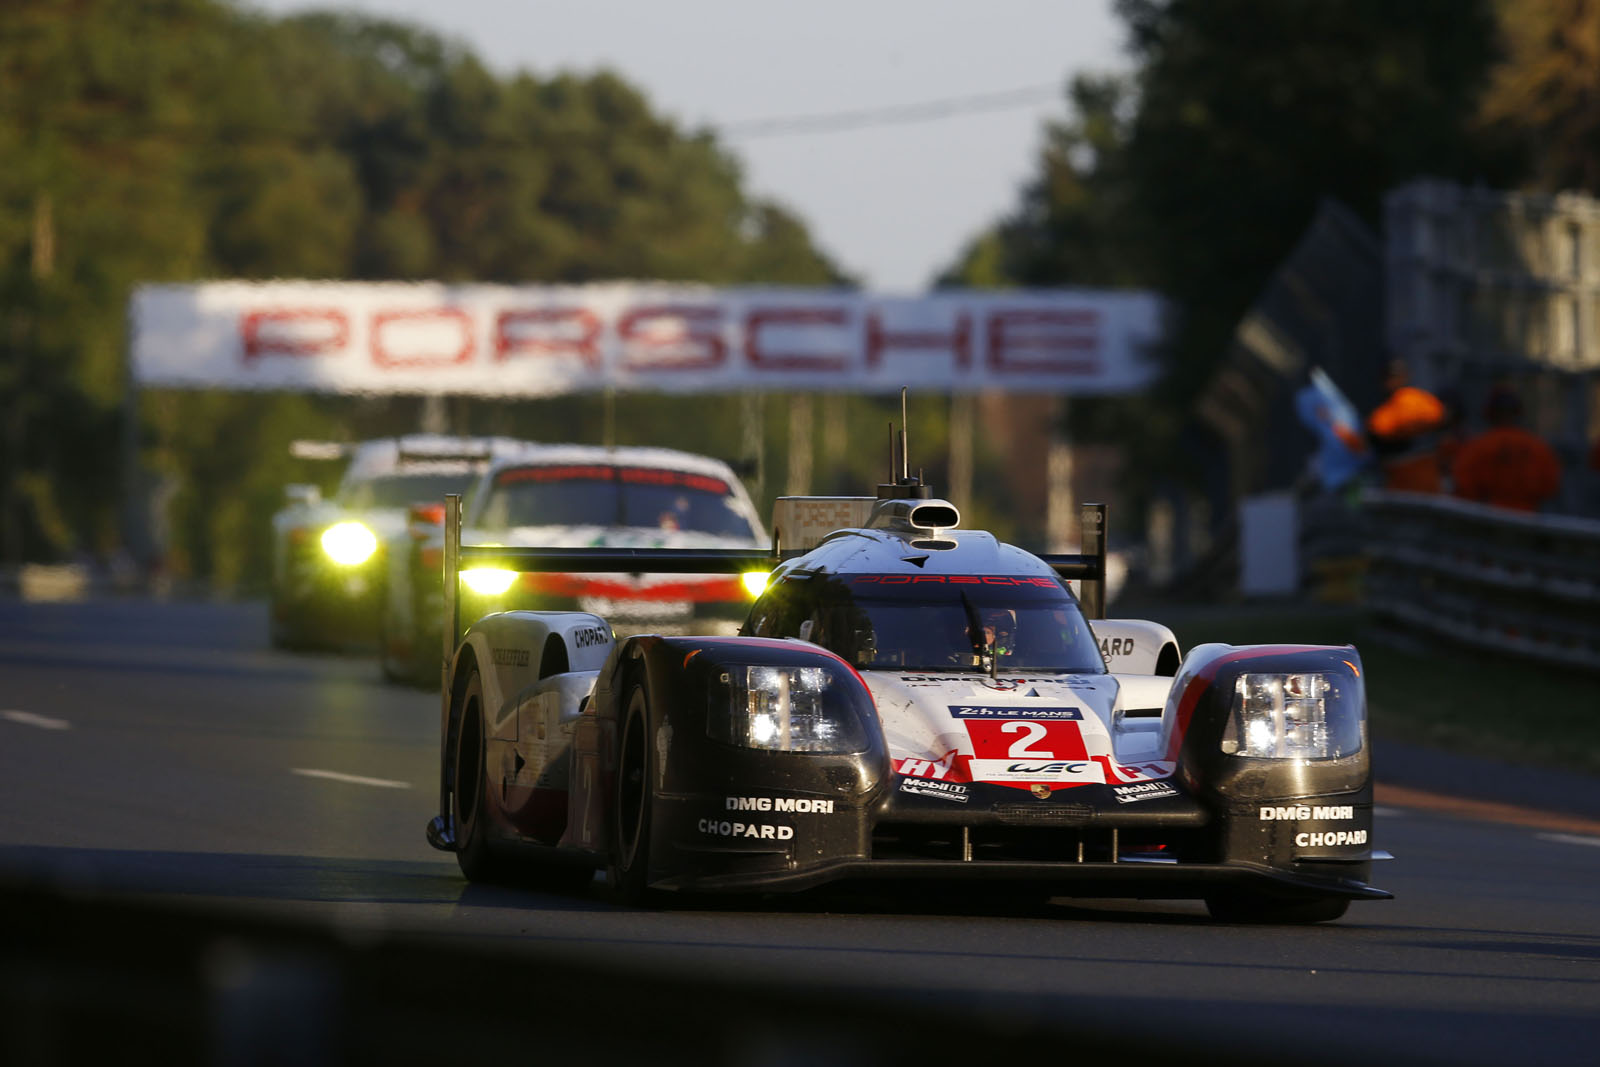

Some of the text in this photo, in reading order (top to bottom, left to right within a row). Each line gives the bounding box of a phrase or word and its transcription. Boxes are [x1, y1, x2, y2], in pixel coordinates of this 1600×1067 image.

[239, 307, 1101, 373] PORSCHE
[852, 575, 1059, 588] PORSCHE
[574, 627, 608, 649] CHOPARD
[1001, 721, 1055, 759] 2
[898, 752, 956, 779] HY
[1007, 763, 1088, 774] WEC
[902, 778, 950, 791] Mobil
[1113, 782, 1158, 795] Mobil
[726, 797, 834, 814] DMG MORI
[1260, 806, 1353, 820] DMG MORI
[699, 819, 793, 840] CHOPARD
[1295, 830, 1367, 847] CHOPARD
